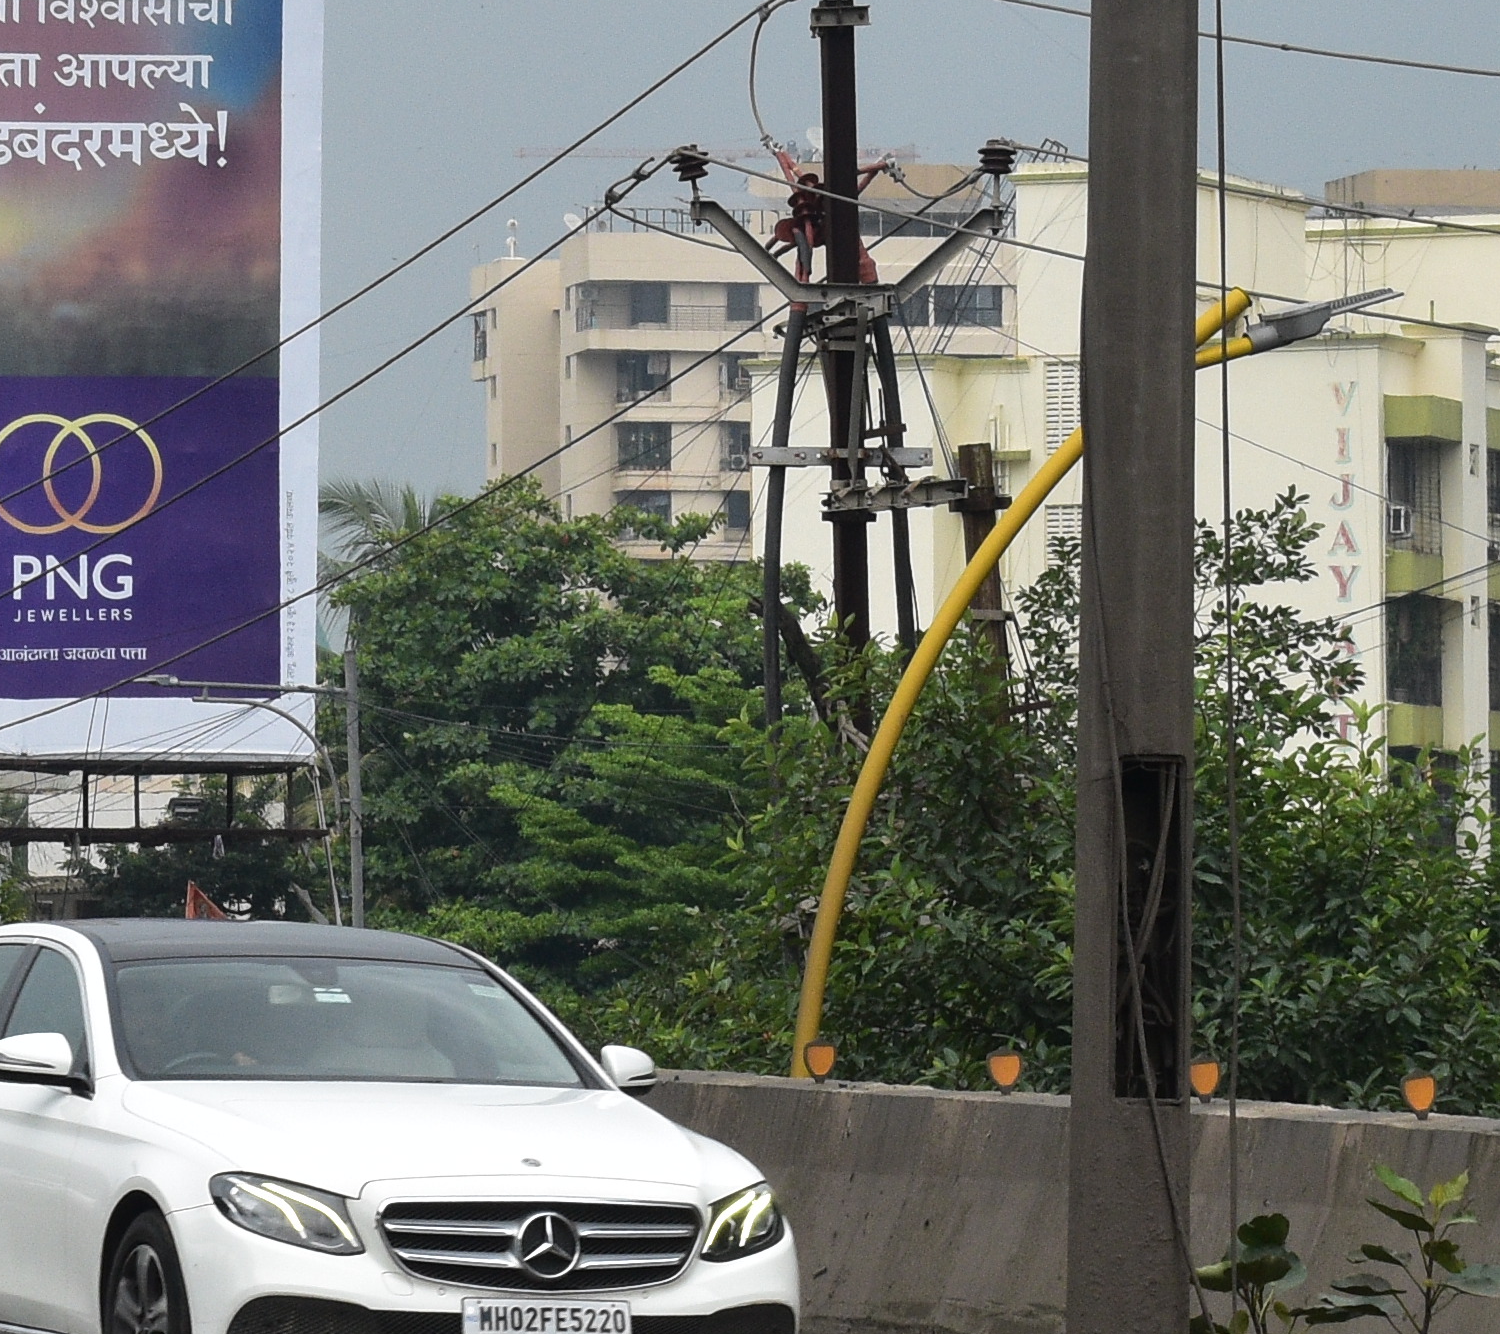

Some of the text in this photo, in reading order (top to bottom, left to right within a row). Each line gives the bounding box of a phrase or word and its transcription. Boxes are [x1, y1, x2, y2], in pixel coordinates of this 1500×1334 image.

[53, 53, 214, 90] आपल्या
[1328, 380, 1360, 603] VIJAY
[13, 553, 133, 600] PNG
[13, 608, 133, 622] JEWELLERS
[120, 647, 148, 660] पत्ता
[479, 1306, 627, 1334] MH02FE5220
